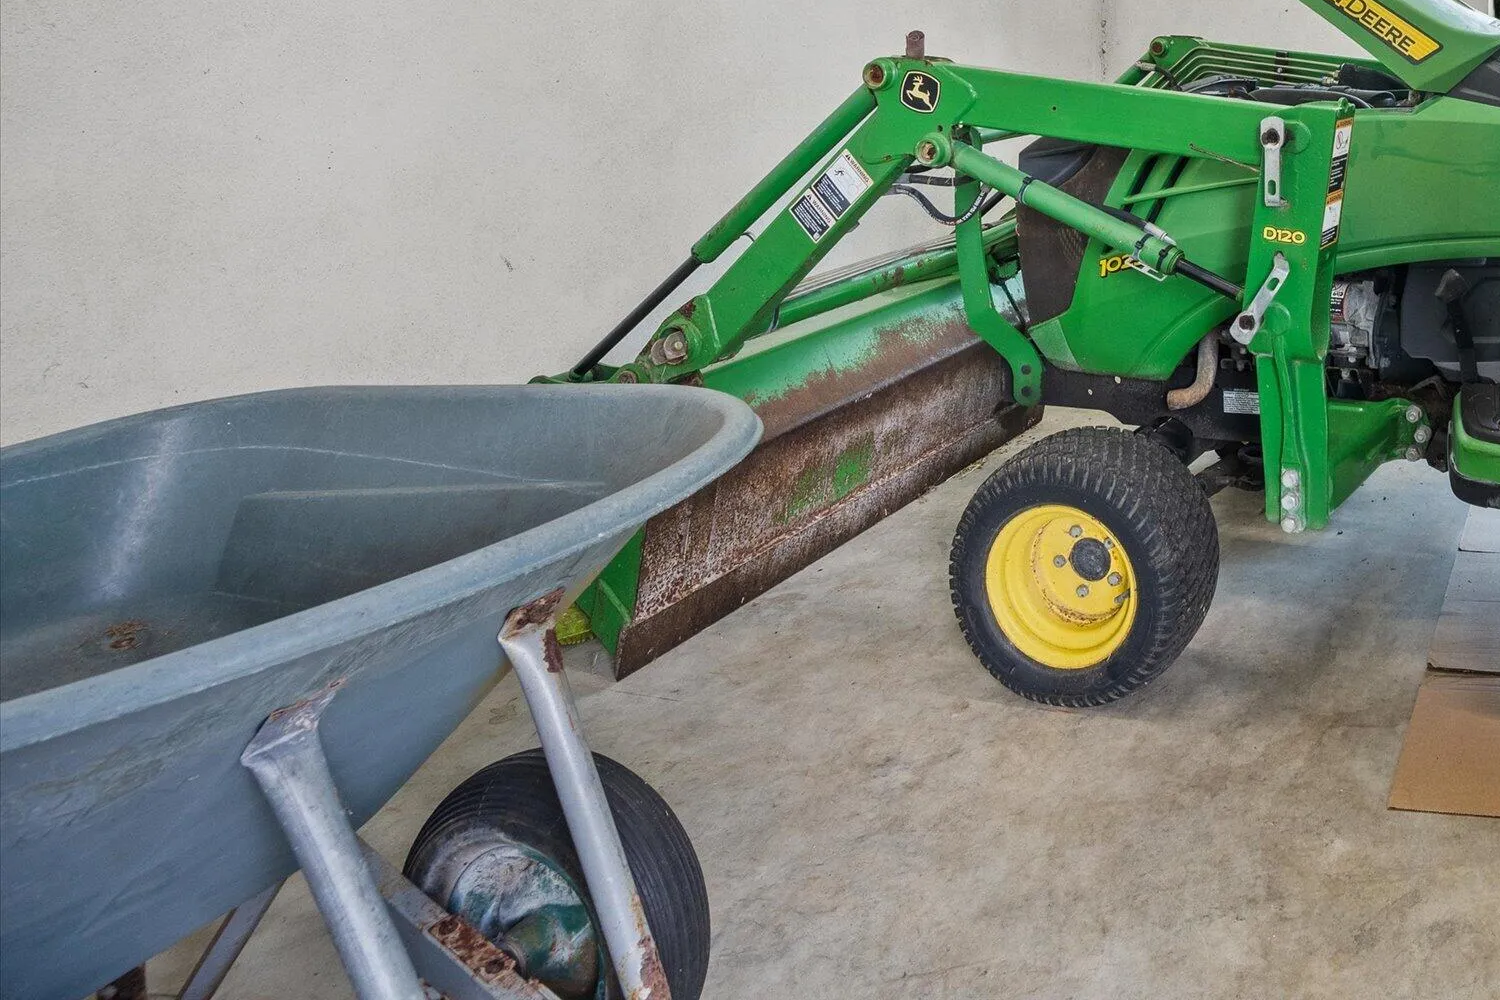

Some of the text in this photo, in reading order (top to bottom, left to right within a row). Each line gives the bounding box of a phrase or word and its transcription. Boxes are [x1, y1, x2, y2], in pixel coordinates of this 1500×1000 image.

[850, 159, 870, 183] WARNING
[812, 199, 831, 223] WARNING
[1263, 226, 1305, 244] D120
